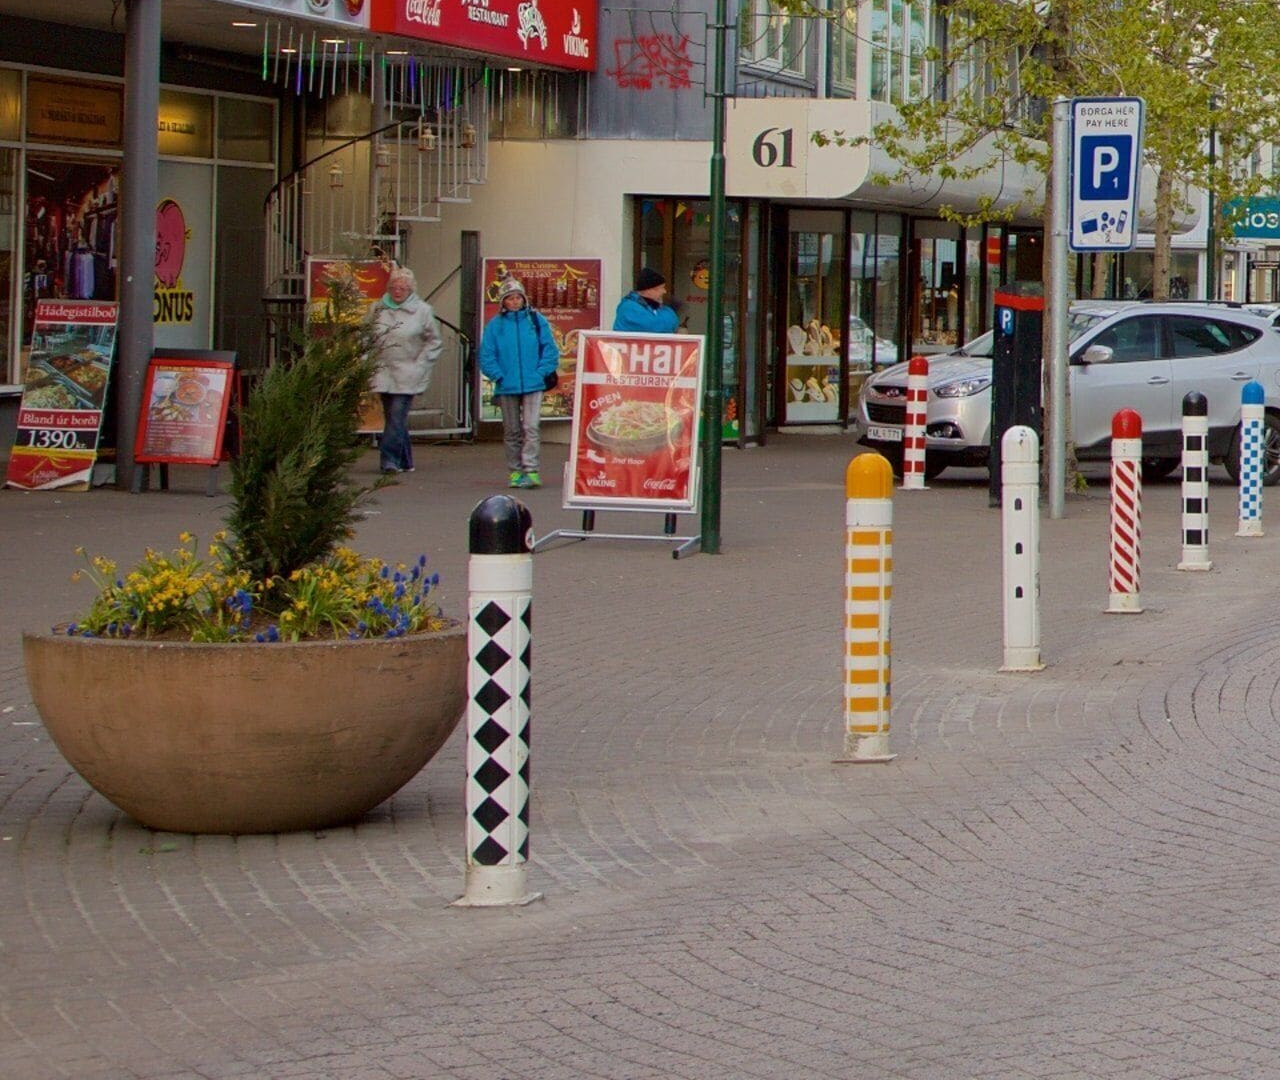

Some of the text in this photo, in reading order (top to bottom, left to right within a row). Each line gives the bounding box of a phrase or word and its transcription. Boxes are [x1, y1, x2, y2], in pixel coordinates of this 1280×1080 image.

[467, 5, 509, 27] RESTAURANT
[1080, 107, 1113, 116] BORGA
[1105, 119, 1129, 127] HERE
[752, 127, 796, 168] 61
[1093, 146, 1119, 189] P
[1112, 177, 1118, 189] 1
[39, 305, 117, 319] Hádegistilboð
[1002, 310, 1011, 329] P
[589, 392, 621, 409] OPEN
[23, 413, 54, 424] Bland
[56, 415, 69, 425] úr
[26, 430, 77, 449] 1390
